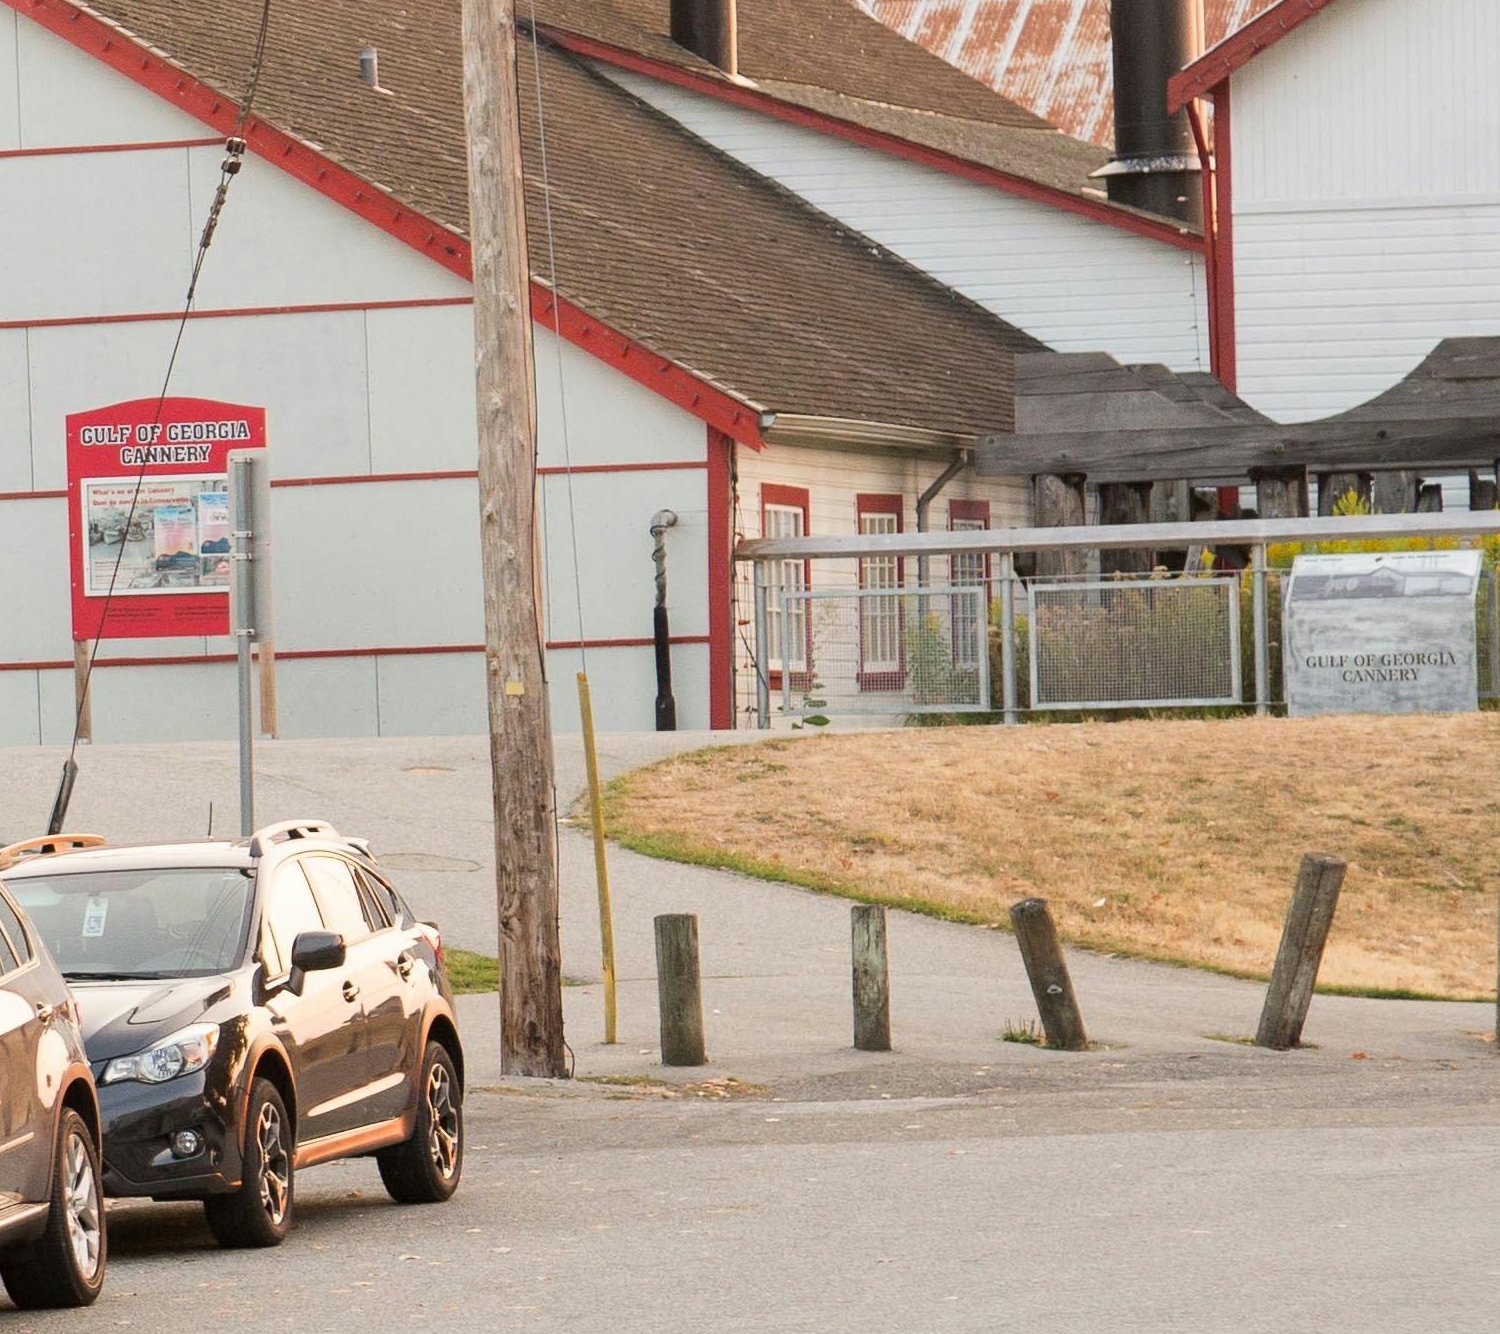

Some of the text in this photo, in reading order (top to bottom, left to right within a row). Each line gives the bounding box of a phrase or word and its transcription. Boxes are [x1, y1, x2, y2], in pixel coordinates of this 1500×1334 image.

[82, 420, 250, 444] GULF OF GEORGIA
[121, 444, 211, 464] CANNERY
[1306, 651, 1457, 668] GULF OF GEORGIA
[1342, 668, 1421, 683] CANNERY
